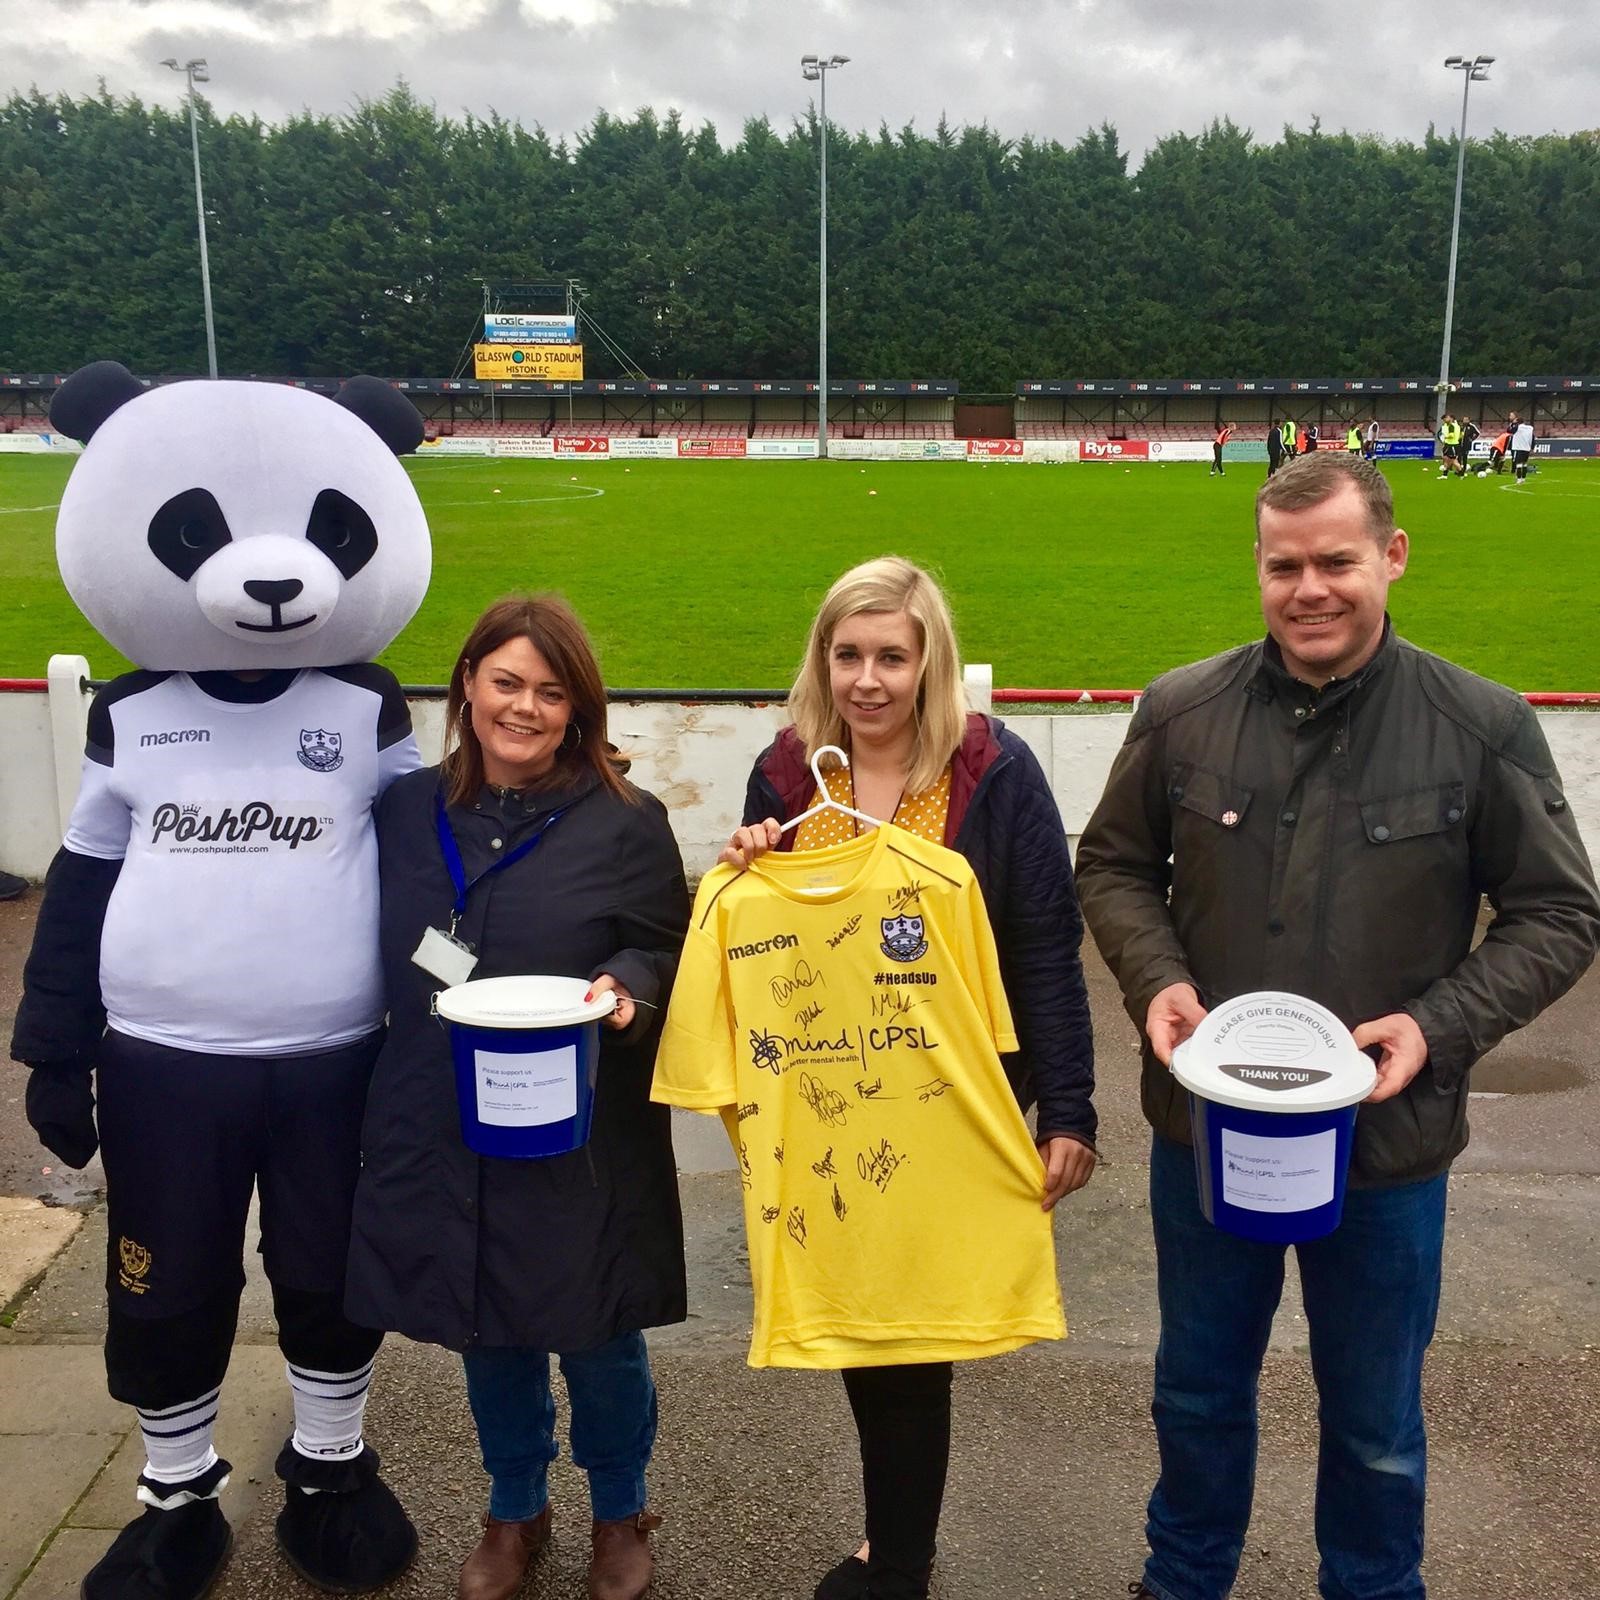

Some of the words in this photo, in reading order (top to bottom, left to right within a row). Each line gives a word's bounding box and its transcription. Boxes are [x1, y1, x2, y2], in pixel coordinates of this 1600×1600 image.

[544, 352, 582, 362] STADIUM
[557, 438, 586, 446] Thurlow
[971, 440, 1000, 448] Thurlow
[1085, 442, 1122, 456] Ryte
[1533, 444, 1551, 453] Hill
[140, 729, 211, 747] macron
[152, 802, 322, 849] PoshPup
[320, 817, 334, 825] LTD
[169, 845, 269, 854] www.poshpupltd.com
[728, 933, 800, 961] macron
[873, 972, 937, 986] #HeadsUp
[1214, 1012, 1246, 1045] PLEASE
[1246, 1007, 1272, 1018] GIVE
[1275, 1007, 1337, 1050] GENEROUSLY
[784, 1028, 855, 1057] mind
[869, 1026, 939, 1051] CPSL
[789, 1057, 808, 1069] better
[810, 1055, 835, 1064] mental
[835, 1054, 859, 1063] health
[500, 1069, 523, 1077] support
[1238, 1068, 1279, 1080] THANK
[1281, 1072, 1309, 1082] YOU!
